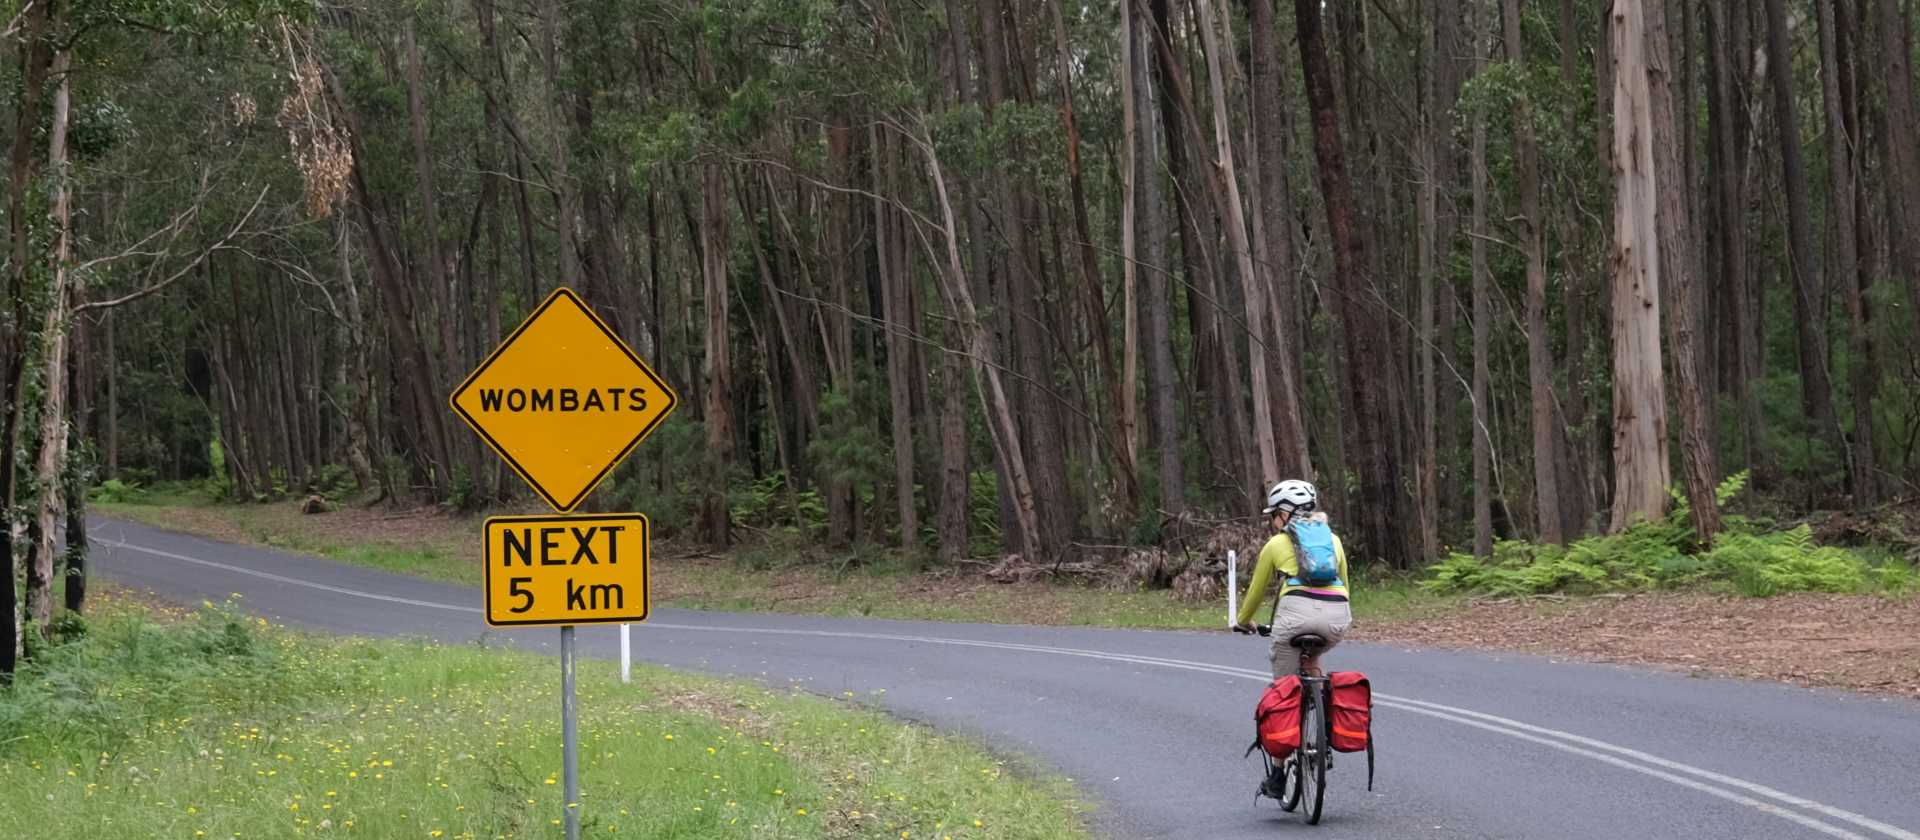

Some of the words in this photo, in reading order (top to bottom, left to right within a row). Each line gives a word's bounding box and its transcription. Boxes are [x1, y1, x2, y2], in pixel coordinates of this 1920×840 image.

[479, 388, 648, 412] WOMBATS
[503, 526, 625, 567] NEXT
[509, 577, 534, 614] 5
[567, 578, 624, 611] km
